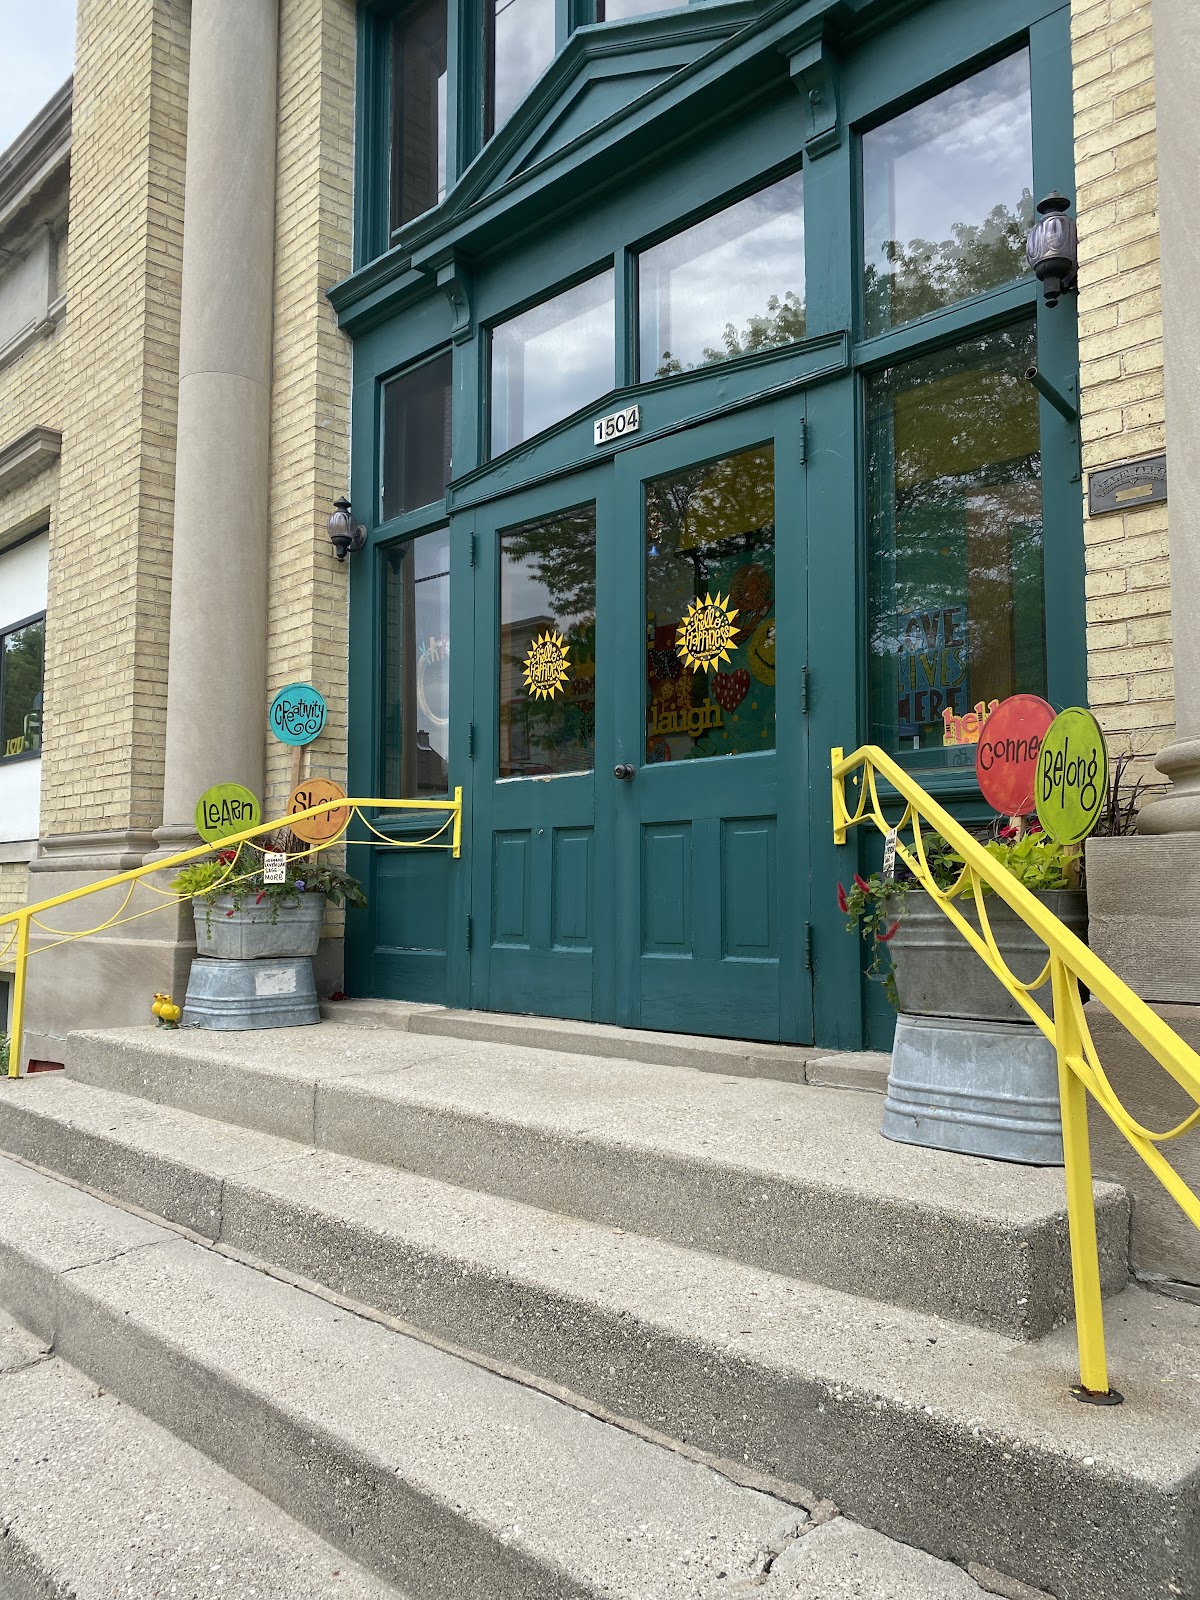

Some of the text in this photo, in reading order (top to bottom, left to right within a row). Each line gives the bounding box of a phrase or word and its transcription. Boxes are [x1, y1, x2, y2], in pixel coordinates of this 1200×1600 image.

[596, 409, 638, 440] 1504
[687, 608, 724, 632] hello
[899, 607, 964, 652] OVE
[531, 644, 560, 665] hello
[898, 648, 968, 692] IVES
[650, 698, 723, 738] laugh
[943, 700, 999, 742] hel
[1042, 736, 1098, 812] Belong
